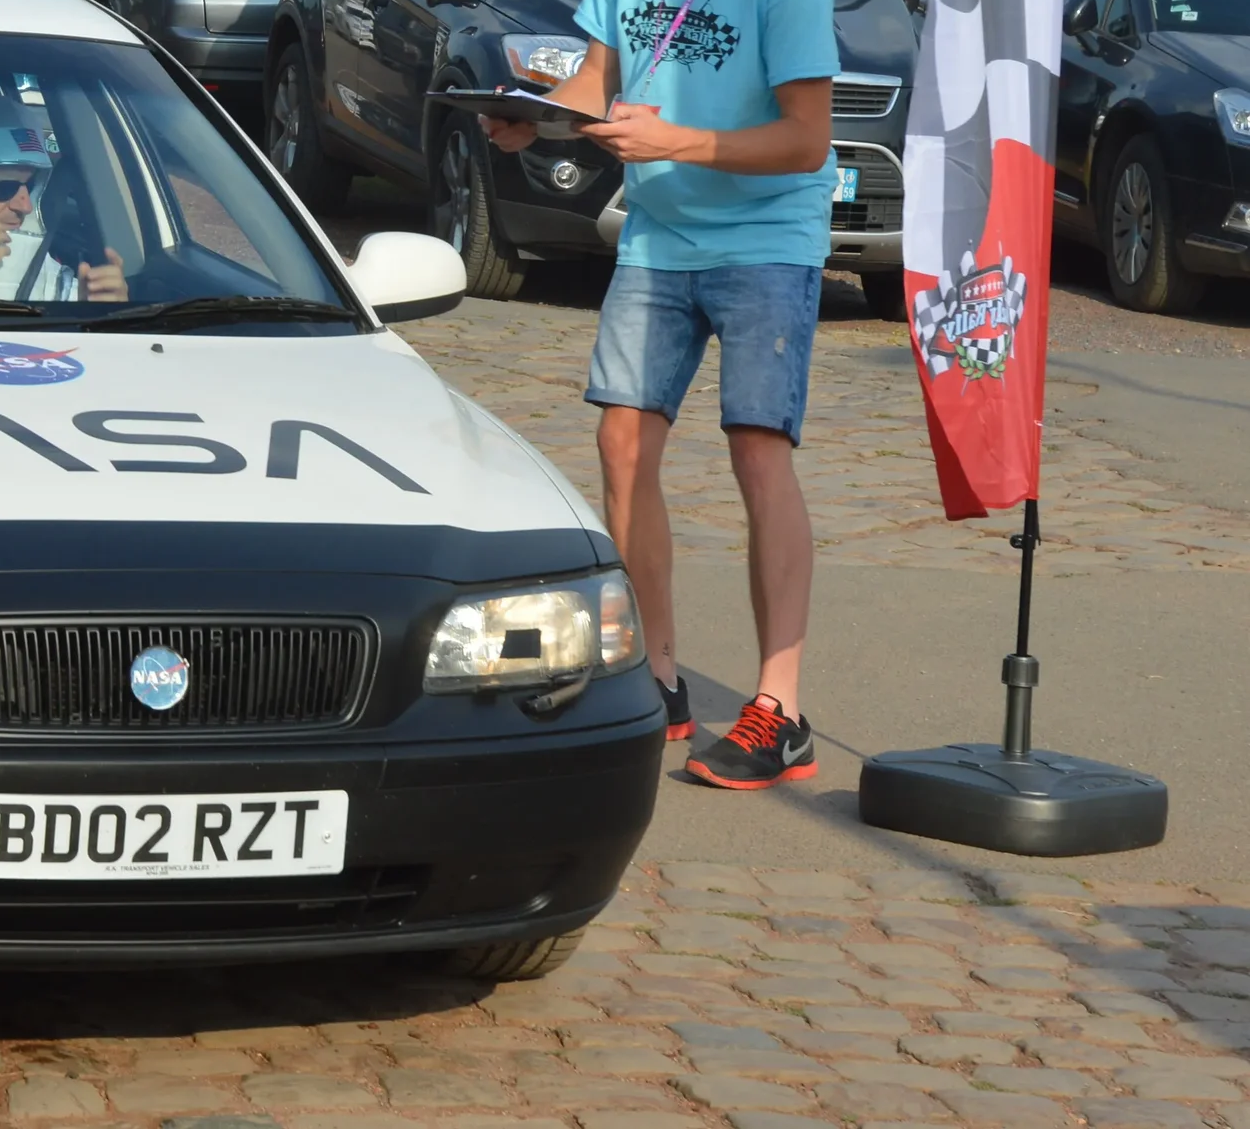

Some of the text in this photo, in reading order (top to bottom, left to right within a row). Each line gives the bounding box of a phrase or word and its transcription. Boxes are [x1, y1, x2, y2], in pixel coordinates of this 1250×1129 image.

[843, 187, 855, 198] 59
[133, 669, 183, 685] NASA
[193, 799, 320, 861] RZT
